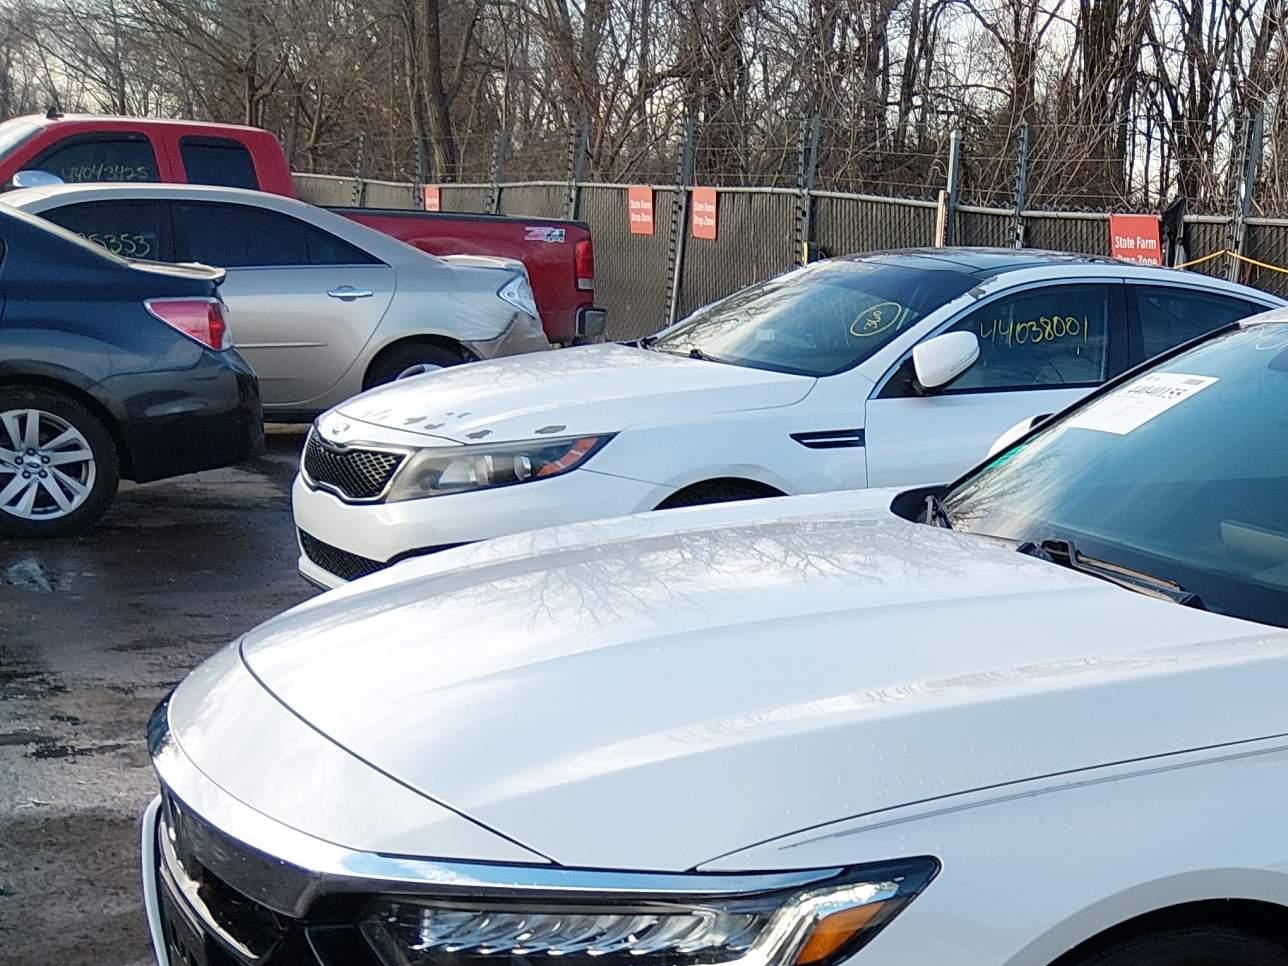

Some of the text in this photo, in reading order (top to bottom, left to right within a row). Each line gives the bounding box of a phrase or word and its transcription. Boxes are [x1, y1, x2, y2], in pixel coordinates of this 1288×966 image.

[1115, 236, 1157, 249] State Farm
[980, 315, 1088, 348] 44038001
